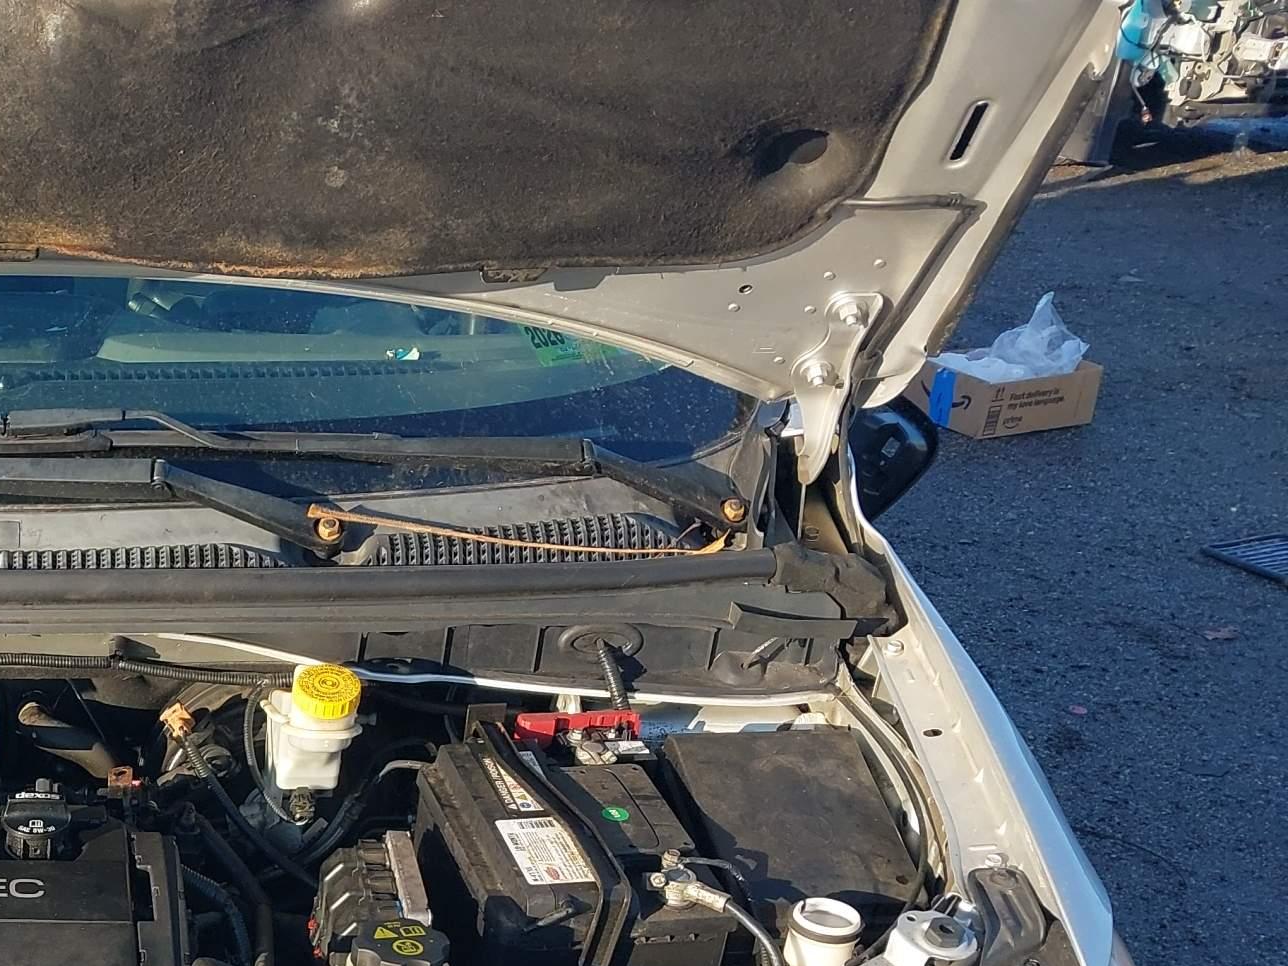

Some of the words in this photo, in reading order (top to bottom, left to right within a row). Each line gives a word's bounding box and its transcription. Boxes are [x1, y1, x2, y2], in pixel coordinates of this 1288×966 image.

[523, 326, 566, 349] 2026
[1024, 390, 1053, 399] delivery
[15, 792, 60, 800] dexos
